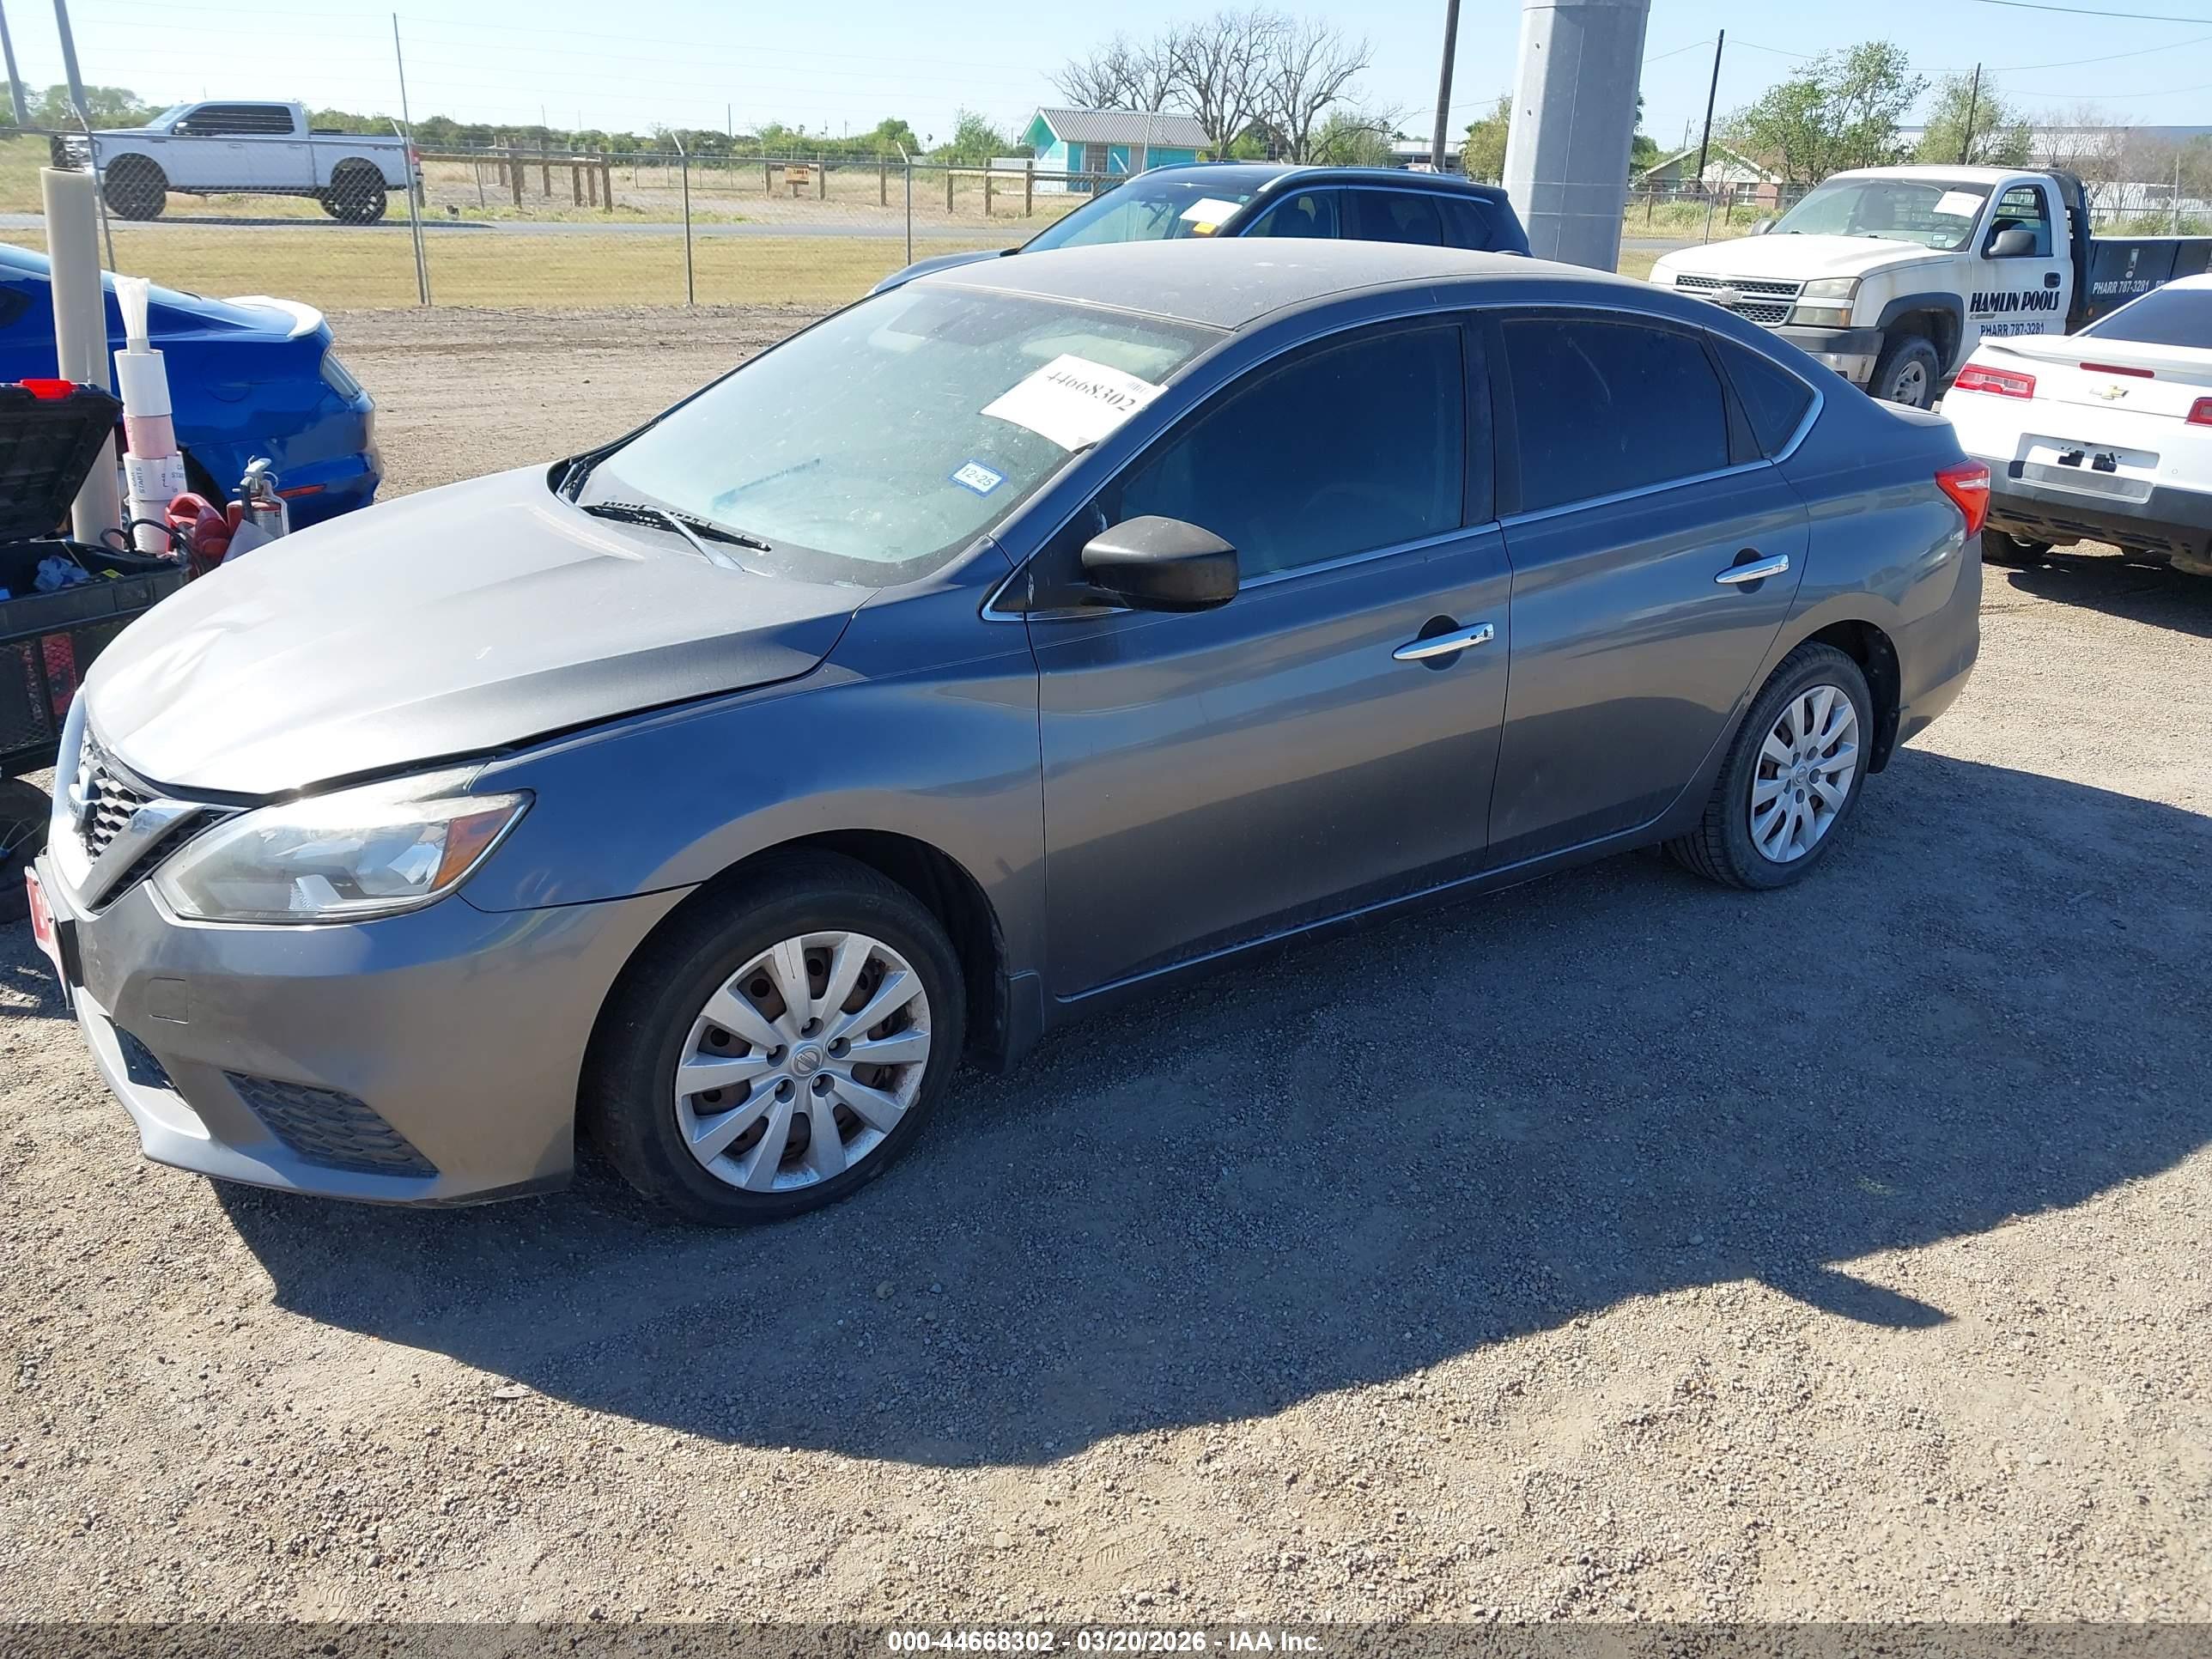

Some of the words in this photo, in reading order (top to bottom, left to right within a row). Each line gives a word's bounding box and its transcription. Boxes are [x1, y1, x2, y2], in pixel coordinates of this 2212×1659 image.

[2092, 280, 2118, 295] PHARR
[2118, 279, 2149, 293] 787-3281
[1969, 292, 2021, 313] HAMLIN
[2021, 290, 2061, 312] POOLS
[1980, 323, 2008, 337] PHARR
[2009, 322, 2045, 337] 787-3281
[1047, 371, 1136, 411] 44668302
[961, 467, 995, 487] 12-25
